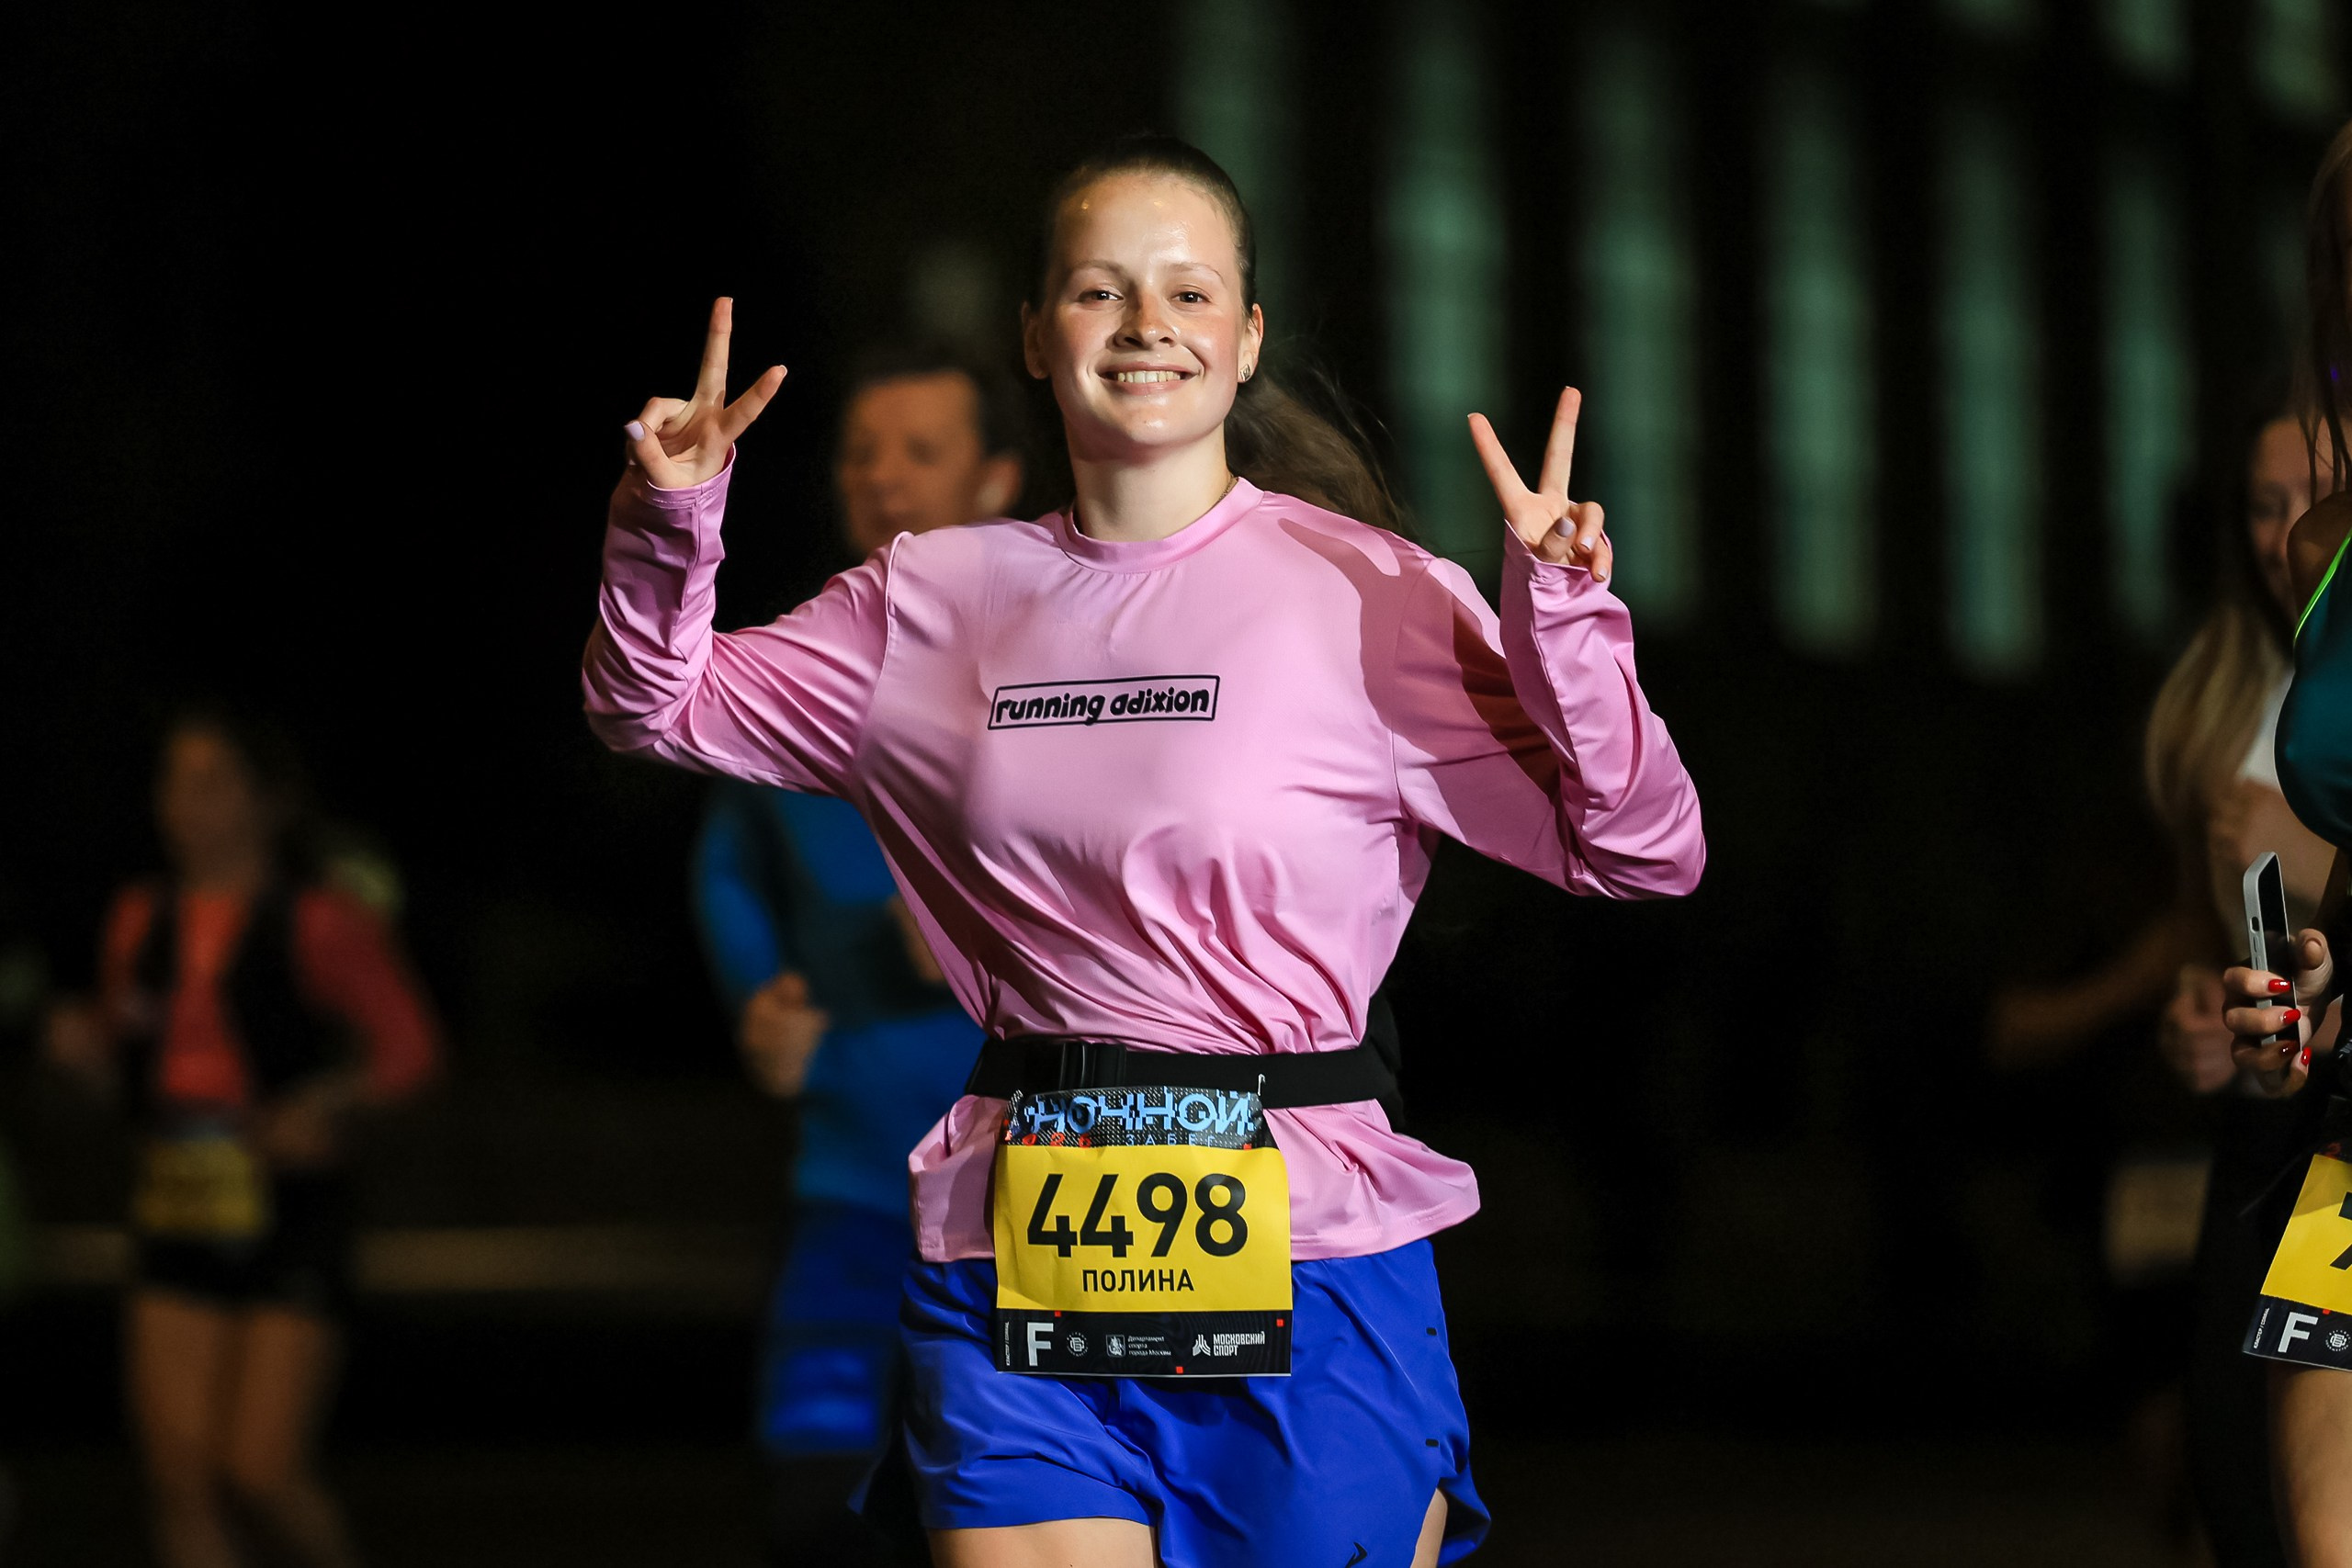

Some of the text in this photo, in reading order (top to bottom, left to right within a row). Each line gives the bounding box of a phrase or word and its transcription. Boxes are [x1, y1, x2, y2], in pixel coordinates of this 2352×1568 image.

[996, 687, 1209, 726] running adixion
[1026, 1088, 1254, 1135] НОЧНОЙ
[1125, 1134, 1216, 1147] ЗАБЕГ
[1027, 1172, 1248, 1258] 4498
[1082, 1269, 1194, 1292] ПОЛИНА
[1027, 1322, 1054, 1367] F
[1213, 1330, 1265, 1345] МОСКОВСКИЙ
[1214, 1345, 1239, 1357] СПОРТ
[2278, 1311, 2319, 1353] F
